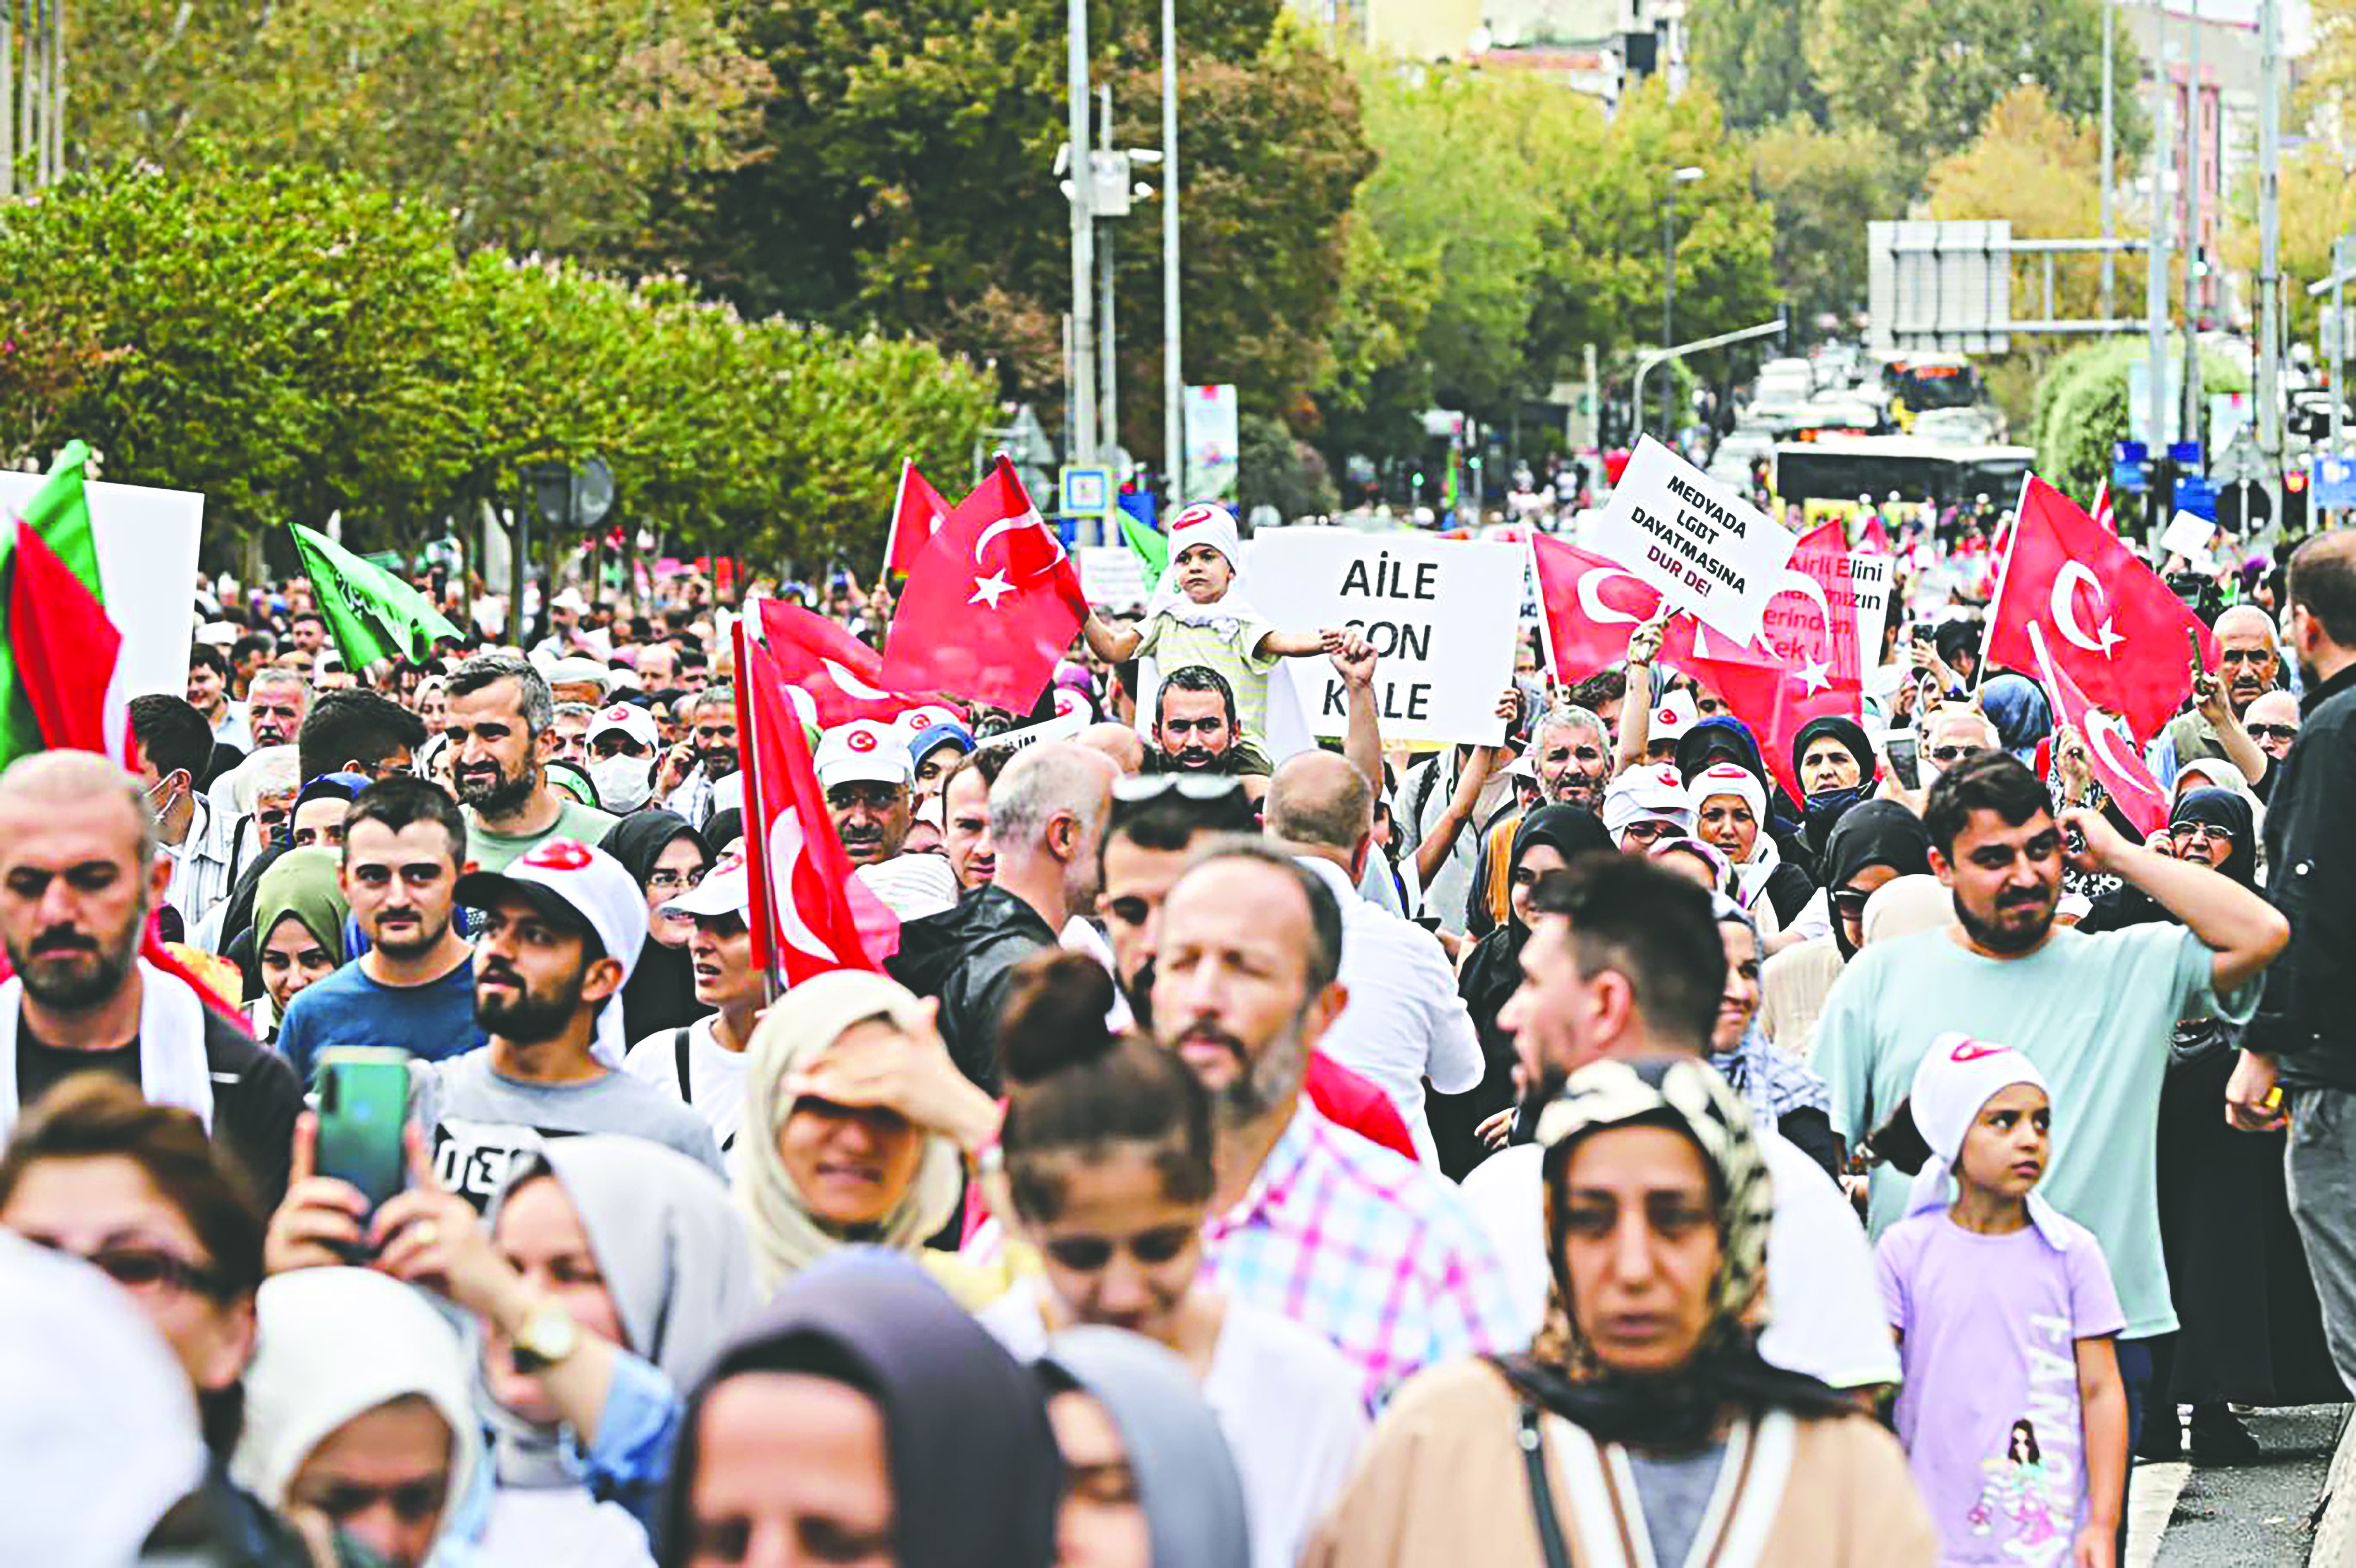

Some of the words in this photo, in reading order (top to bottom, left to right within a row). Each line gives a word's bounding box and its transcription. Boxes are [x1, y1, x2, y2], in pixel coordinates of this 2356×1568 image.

[1667, 475, 1747, 539] MEDYADA
[1677, 508, 1719, 545] LGBT
[1340, 550, 1438, 600] AİLE
[1630, 506, 1746, 594] DAYATMASINA
[1647, 545, 1683, 577] DUR
[1684, 570, 1713, 598] DE!
[1836, 558, 1883, 582] Elini
[1322, 679, 1431, 720] KLE
